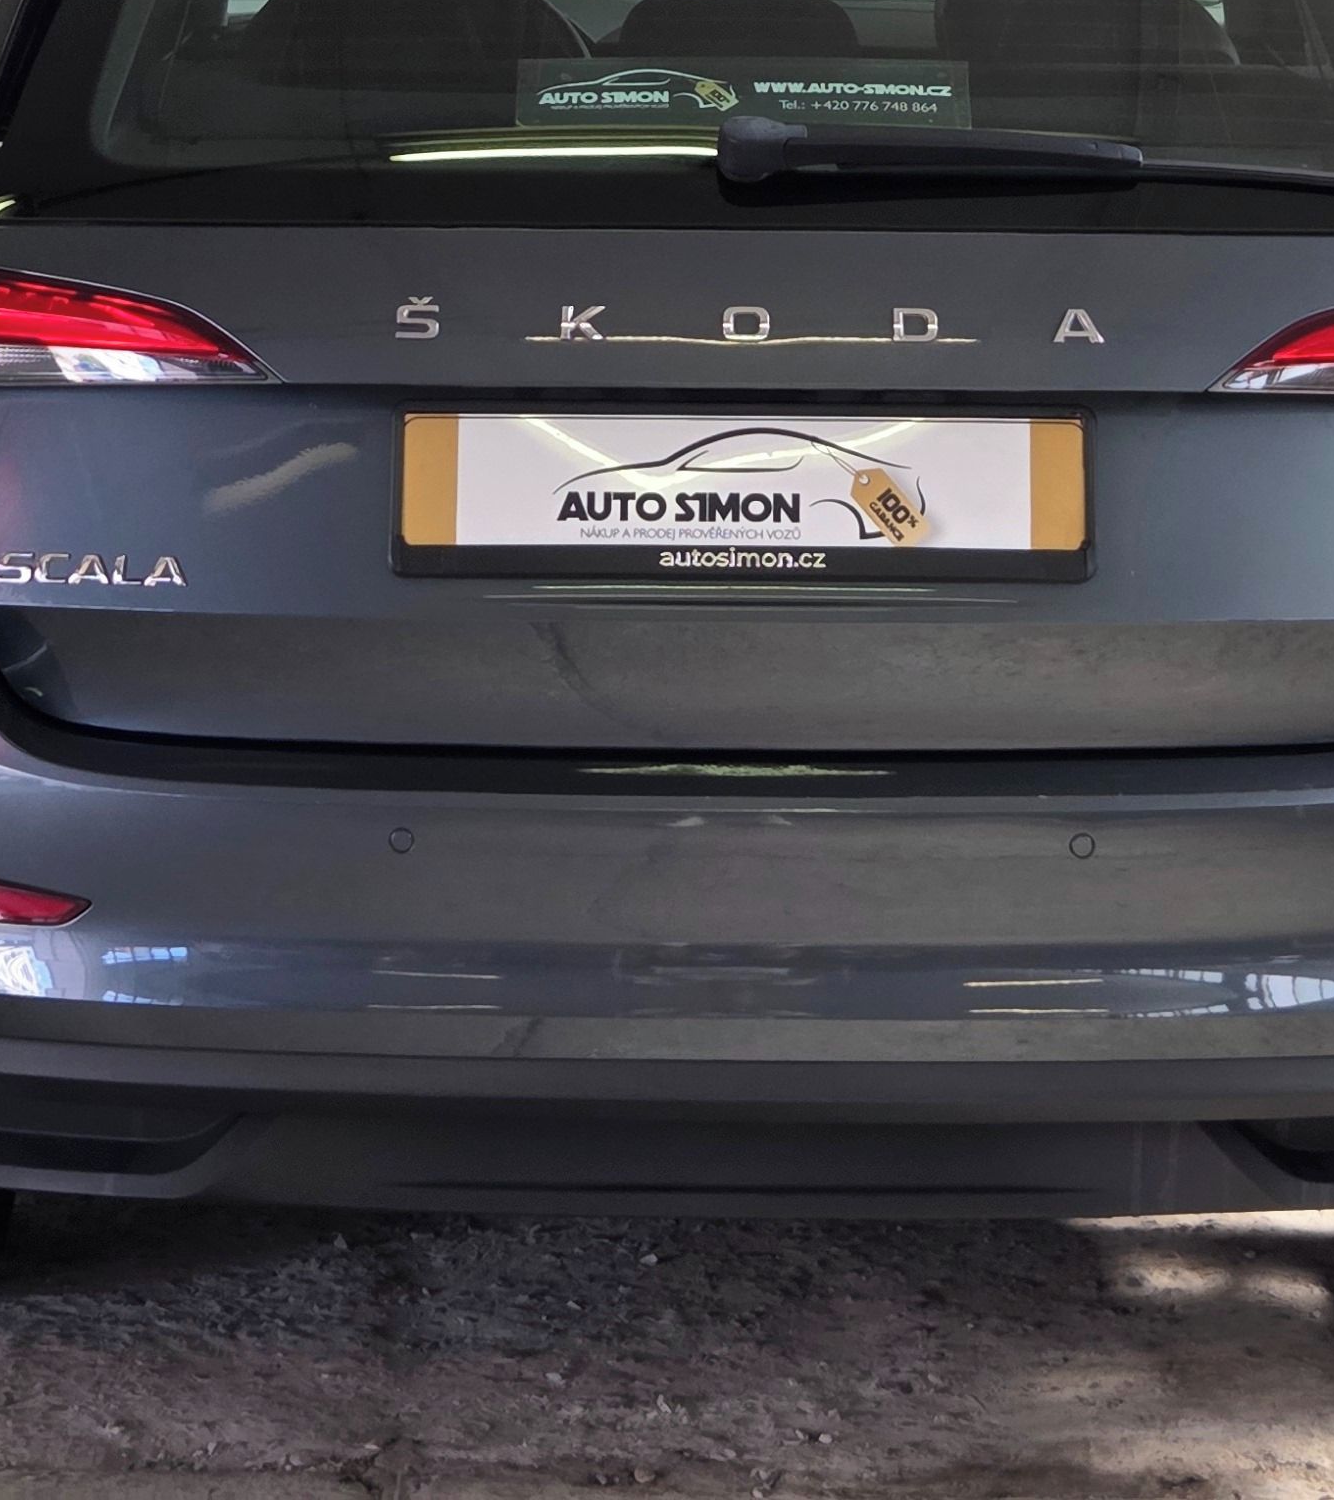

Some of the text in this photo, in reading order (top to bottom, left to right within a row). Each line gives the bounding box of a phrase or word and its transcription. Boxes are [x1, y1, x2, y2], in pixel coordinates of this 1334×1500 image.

[538, 90, 670, 105] AUTO SIMON
[753, 81, 952, 97] WWW.AUTO-SIMON.CZ
[779, 99, 938, 114] Tel.: +420 776 748 864
[395, 296, 1105, 344] ŠKODA
[557, 491, 800, 523] AUTO SIMON
[876, 487, 919, 529] 100%
[580, 525, 620, 539] NÁKUP
[622, 529, 630, 539] A
[633, 528, 676, 541] PRODEJ
[659, 546, 827, 569] autosimon.cz
